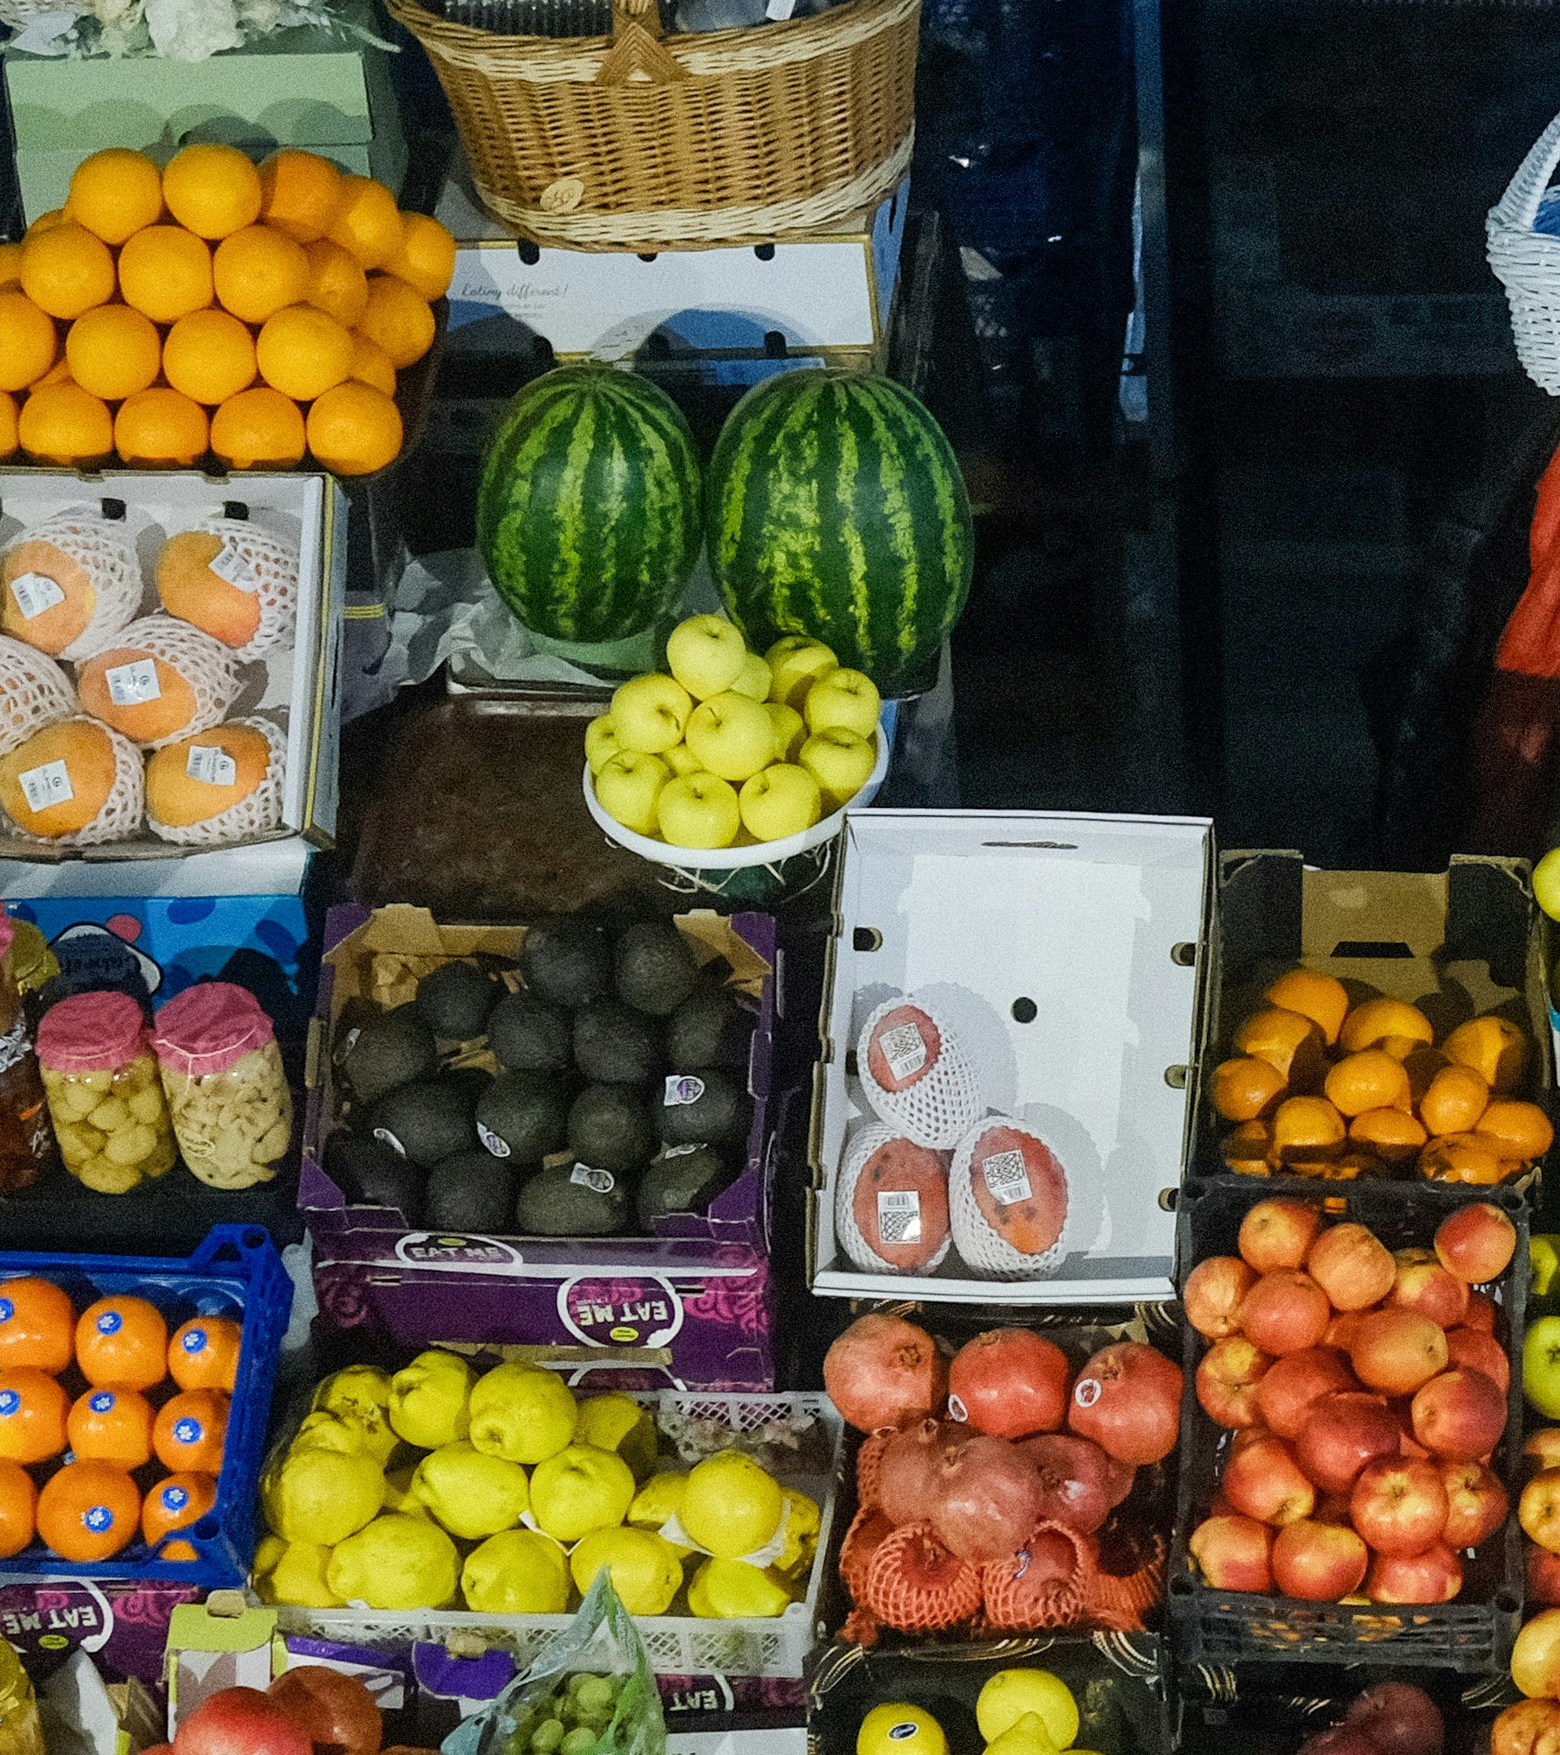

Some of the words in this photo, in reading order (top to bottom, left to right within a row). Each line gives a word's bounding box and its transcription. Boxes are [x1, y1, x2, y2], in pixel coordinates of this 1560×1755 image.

[411, 1246, 460, 1259] EAT
[463, 1246, 501, 1260] ME
[577, 1305, 614, 1326] ME
[619, 1300, 669, 1322] EAT
[2, 1610, 42, 1635] ME
[48, 1606, 98, 1629] EAT
[670, 1690, 718, 1711] EAT
